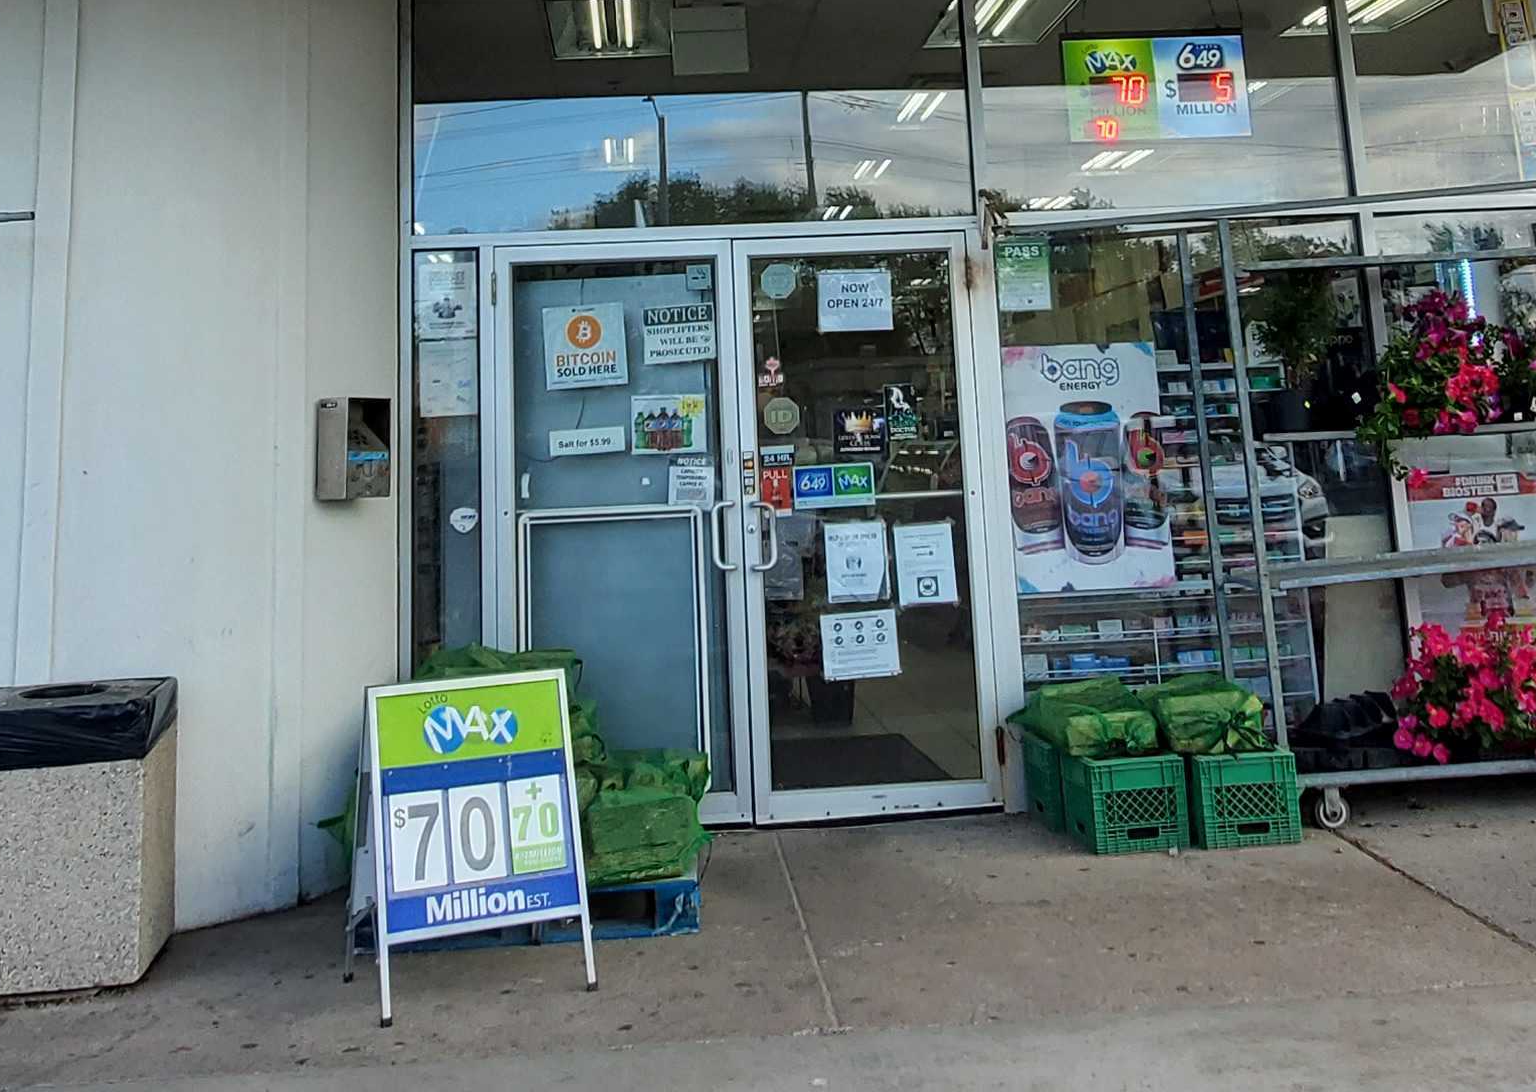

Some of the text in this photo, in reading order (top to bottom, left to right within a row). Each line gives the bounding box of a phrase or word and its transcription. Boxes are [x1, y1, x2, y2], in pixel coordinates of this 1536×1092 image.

[1085, 51, 1136, 74] MAX
[1112, 75, 1145, 104] 70
[1215, 73, 1231, 103] 5
[1176, 103, 1237, 115] MILLION
[1096, 119, 1117, 138] 70
[1004, 245, 1040, 258] PASS
[840, 283, 870, 294] NOW
[827, 297, 884, 309] OPEN 24/7
[647, 306, 708, 325] NOTICE
[646, 323, 710, 336] SHOPLIFTERS
[659, 336, 699, 346] WILL BE
[555, 350, 616, 368] BITCOIN
[649, 346, 711, 358] PROSECUTED
[557, 363, 617, 378] SOLD HERE
[1040, 353, 1120, 386] bang
[1059, 380, 1102, 391] ENERGY
[770, 410, 793, 423] ID
[558, 440, 574, 449] Salt
[576, 439, 588, 448] for
[763, 469, 788, 480] PULL
[838, 474, 869, 491] MAX
[417, 694, 449, 715] Lotto
[424, 705, 514, 754] MAX
[512, 801, 560, 842] 70
[394, 796, 497, 882] $70
[426, 887, 526, 925] Million
